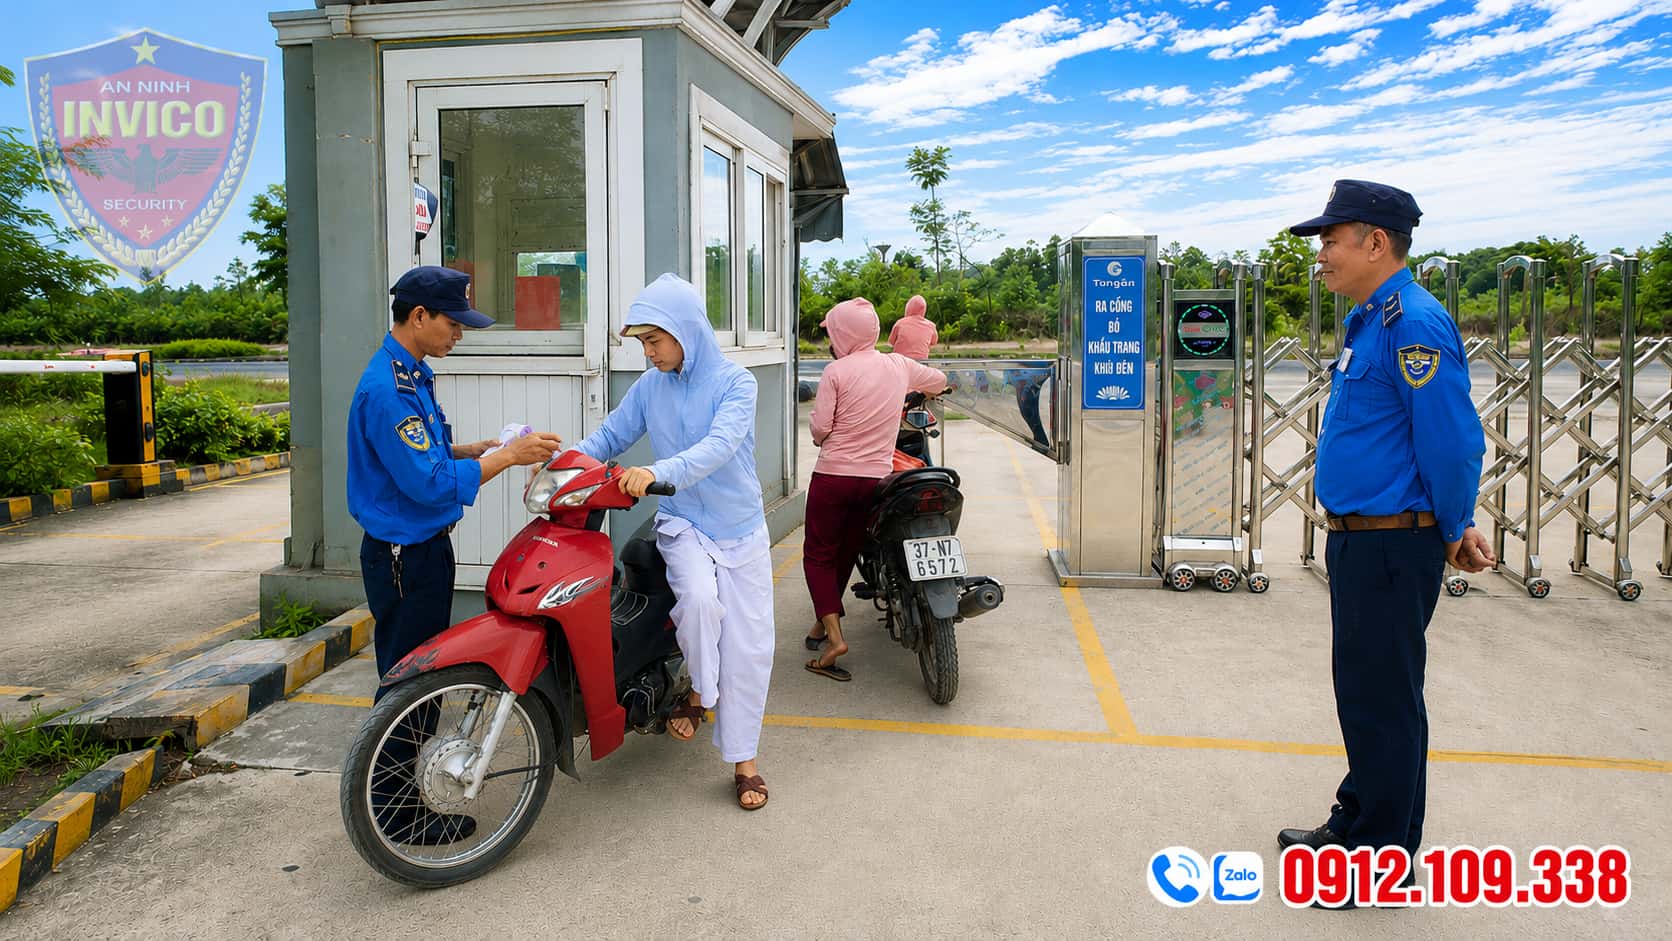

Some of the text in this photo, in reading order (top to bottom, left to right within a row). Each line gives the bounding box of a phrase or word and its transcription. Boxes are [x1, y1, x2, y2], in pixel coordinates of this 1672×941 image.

[1095, 300, 1107, 313] RA
[1112, 341, 1140, 354] TRANG
[917, 558, 959, 576] 6572
